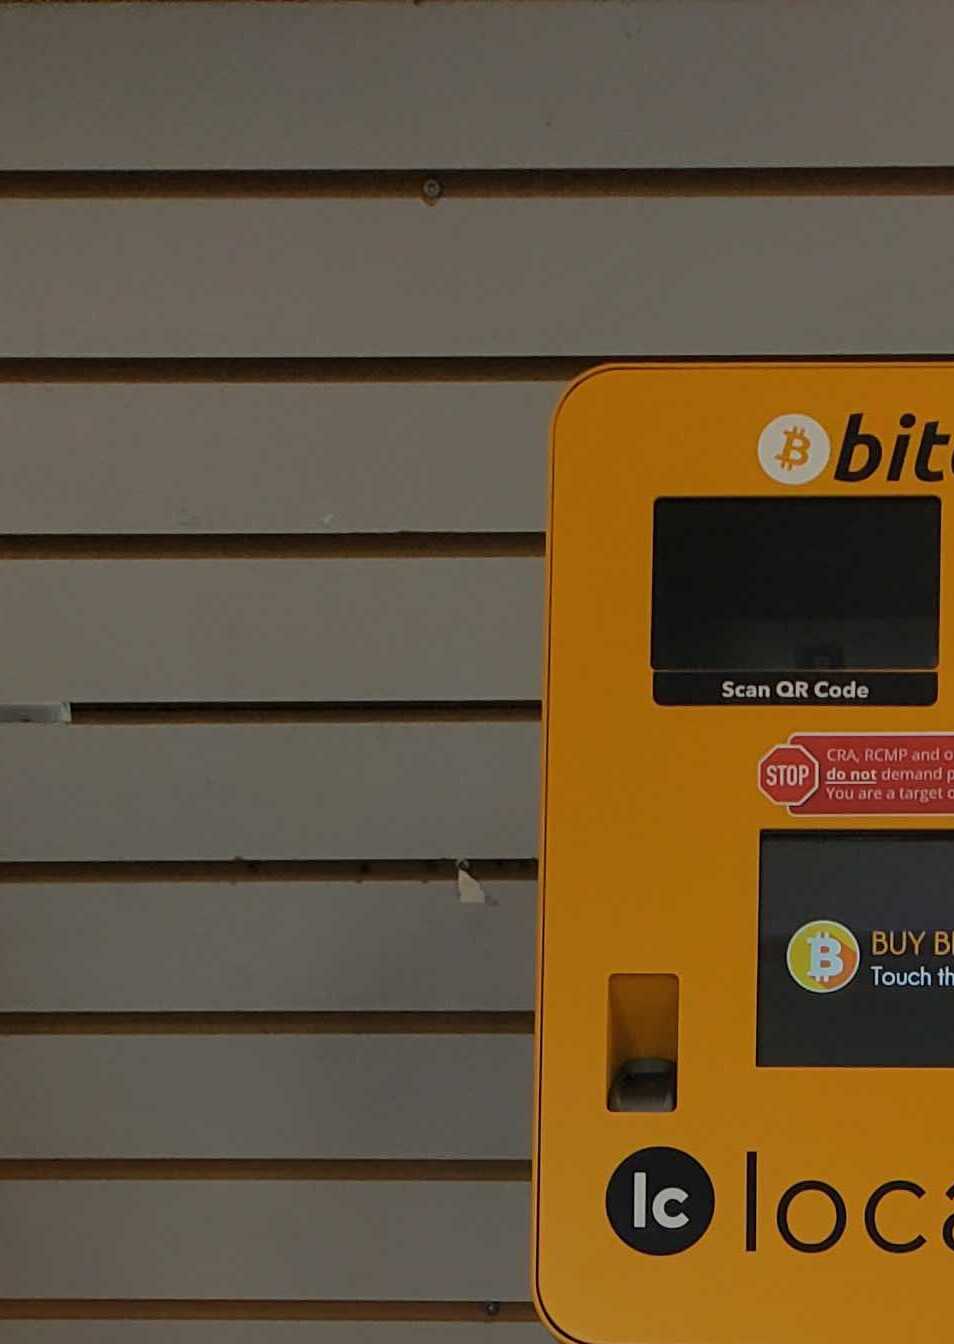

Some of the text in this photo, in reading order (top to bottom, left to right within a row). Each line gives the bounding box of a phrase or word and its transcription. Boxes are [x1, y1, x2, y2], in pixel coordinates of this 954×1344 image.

[721, 680, 870, 702] Scan QR Code
[826, 748, 861, 763] CRA,
[864, 748, 908, 762] RCMP
[912, 748, 940, 762] and
[765, 764, 810, 787] STOP
[826, 767, 846, 781] do
[850, 767, 877, 781] not
[881, 767, 943, 781] demand
[825, 786, 854, 800] You
[860, 789, 882, 800] are
[886, 789, 896, 800] a
[900, 787, 943, 803] target
[871, 930, 926, 956] BUY
[870, 966, 933, 987] Touch
